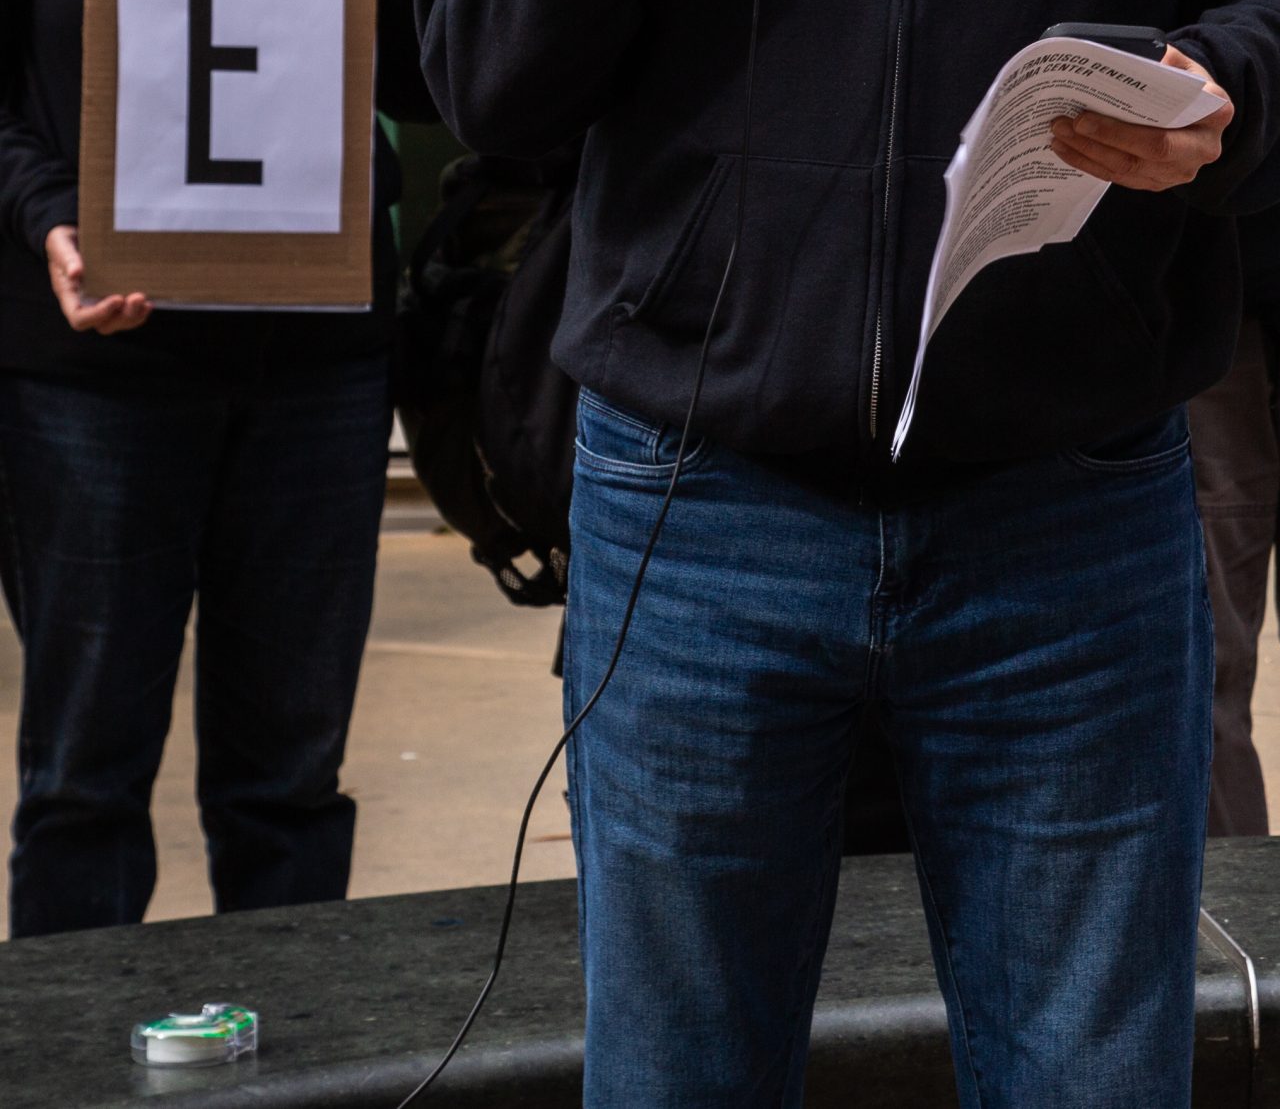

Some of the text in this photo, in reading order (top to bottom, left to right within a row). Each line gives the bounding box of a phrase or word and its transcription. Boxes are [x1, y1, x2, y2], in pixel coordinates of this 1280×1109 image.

[1020, 53, 1089, 74] FRANCISCO
[1090, 62, 1150, 92] GENERAL
[1042, 63, 1094, 77] CENTER
